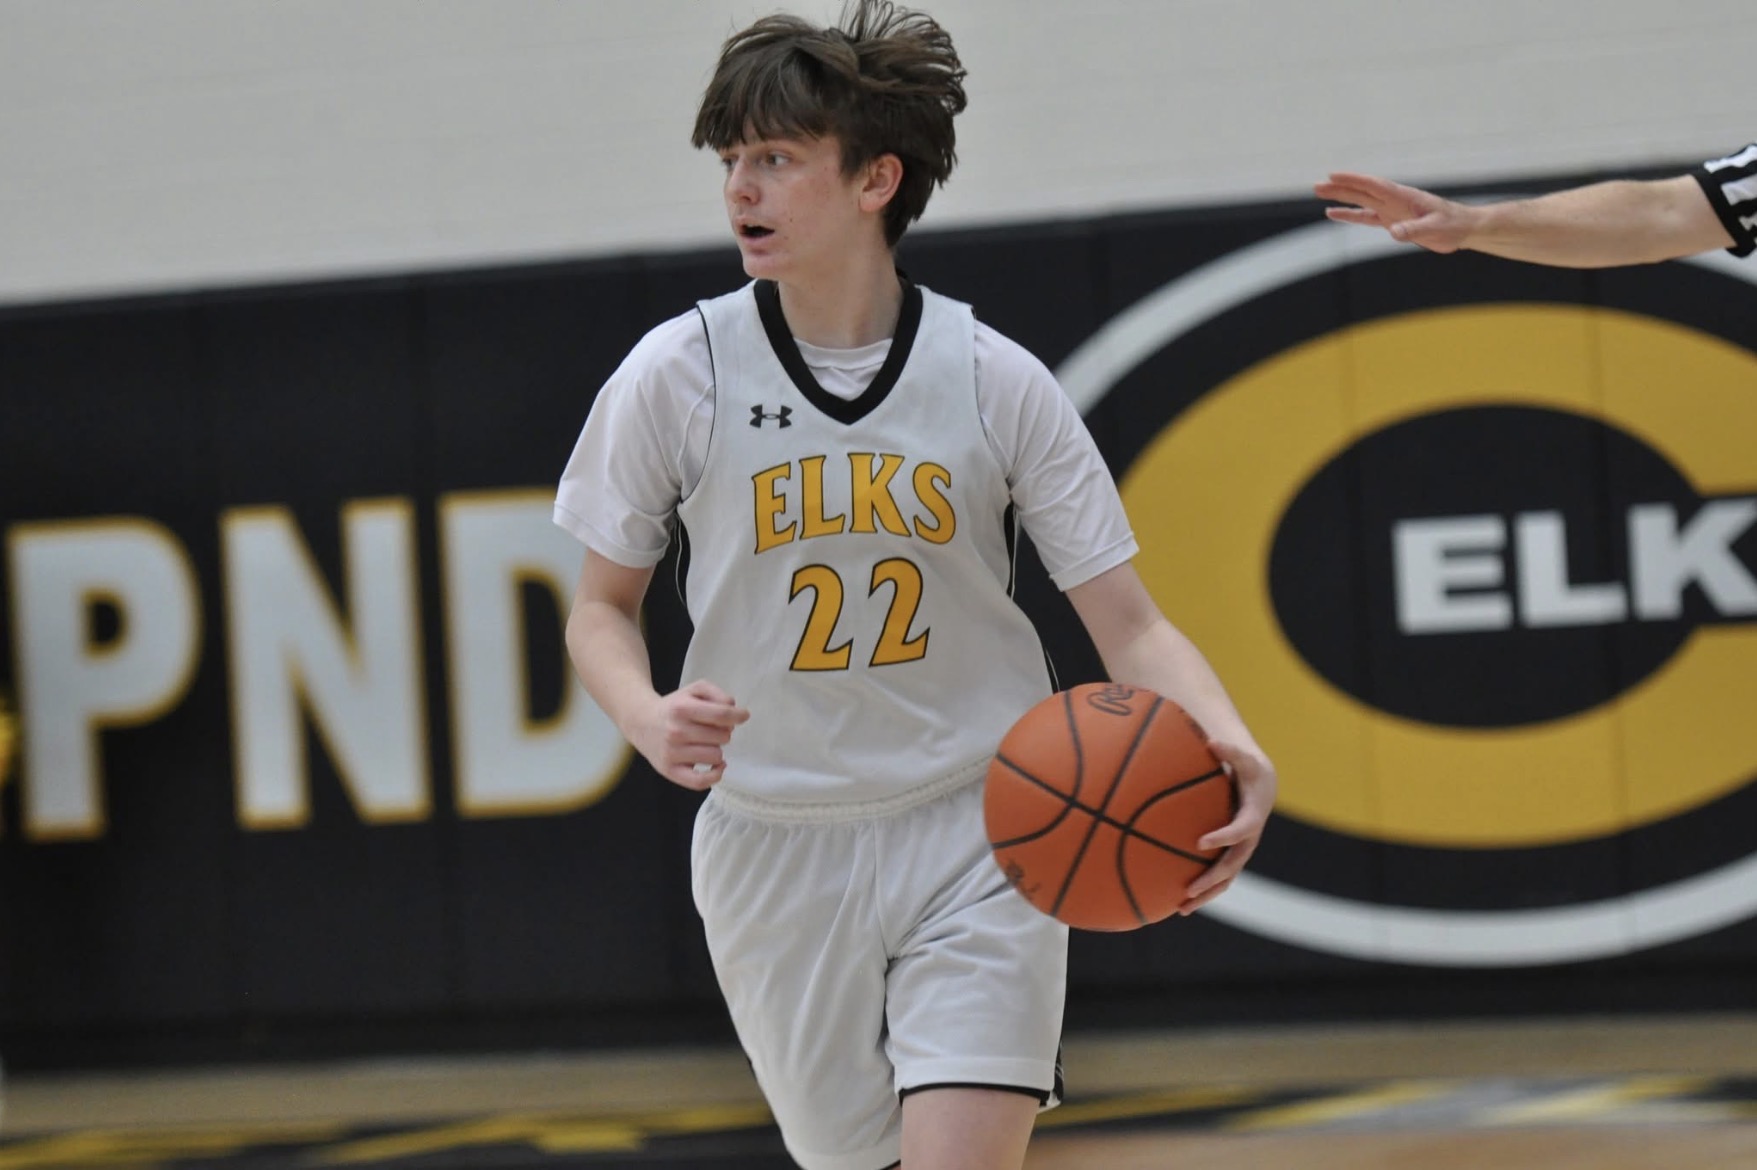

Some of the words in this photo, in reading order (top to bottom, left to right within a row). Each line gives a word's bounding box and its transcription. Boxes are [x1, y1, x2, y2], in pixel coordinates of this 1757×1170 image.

[751, 452, 957, 555] ELKS
[788, 556, 930, 672] 22
[1392, 498, 1757, 636] ELK
